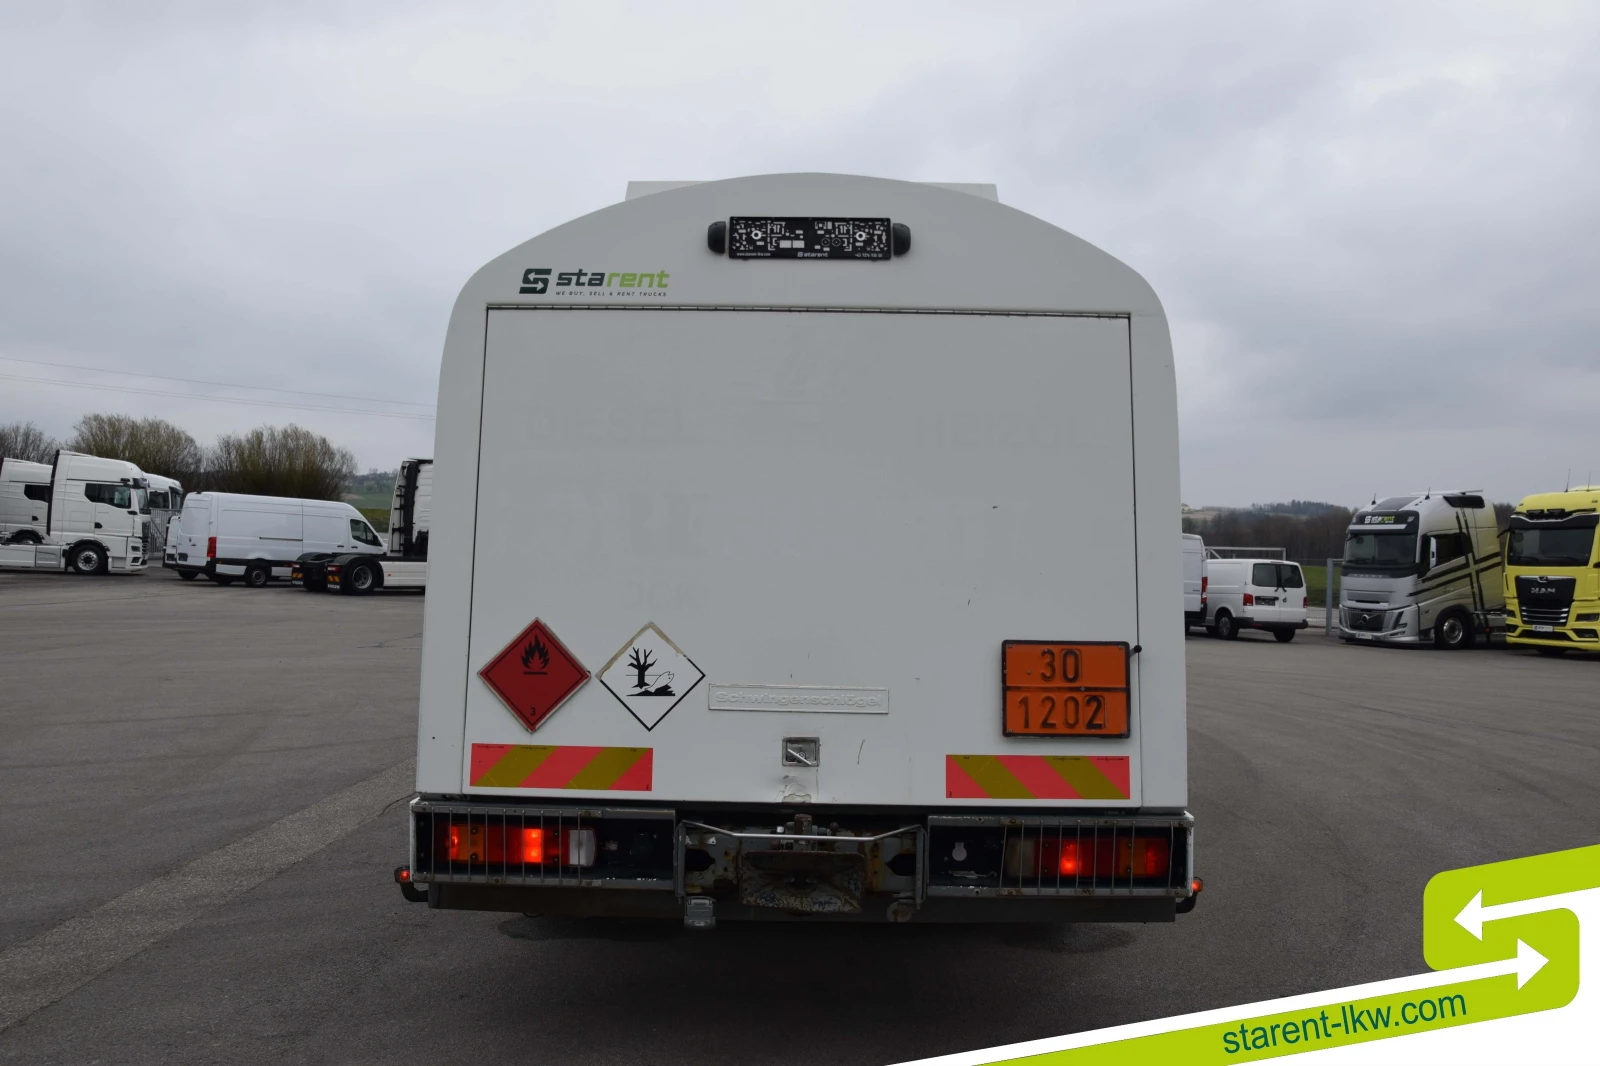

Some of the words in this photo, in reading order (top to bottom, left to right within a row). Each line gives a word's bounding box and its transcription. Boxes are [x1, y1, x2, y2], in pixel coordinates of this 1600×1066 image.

[556, 268, 670, 288] starent
[1039, 648, 1081, 683] 30
[714, 690, 883, 708] Schwingenschlögel
[529, 706, 537, 717] 3
[1017, 694, 1104, 730] 1202
